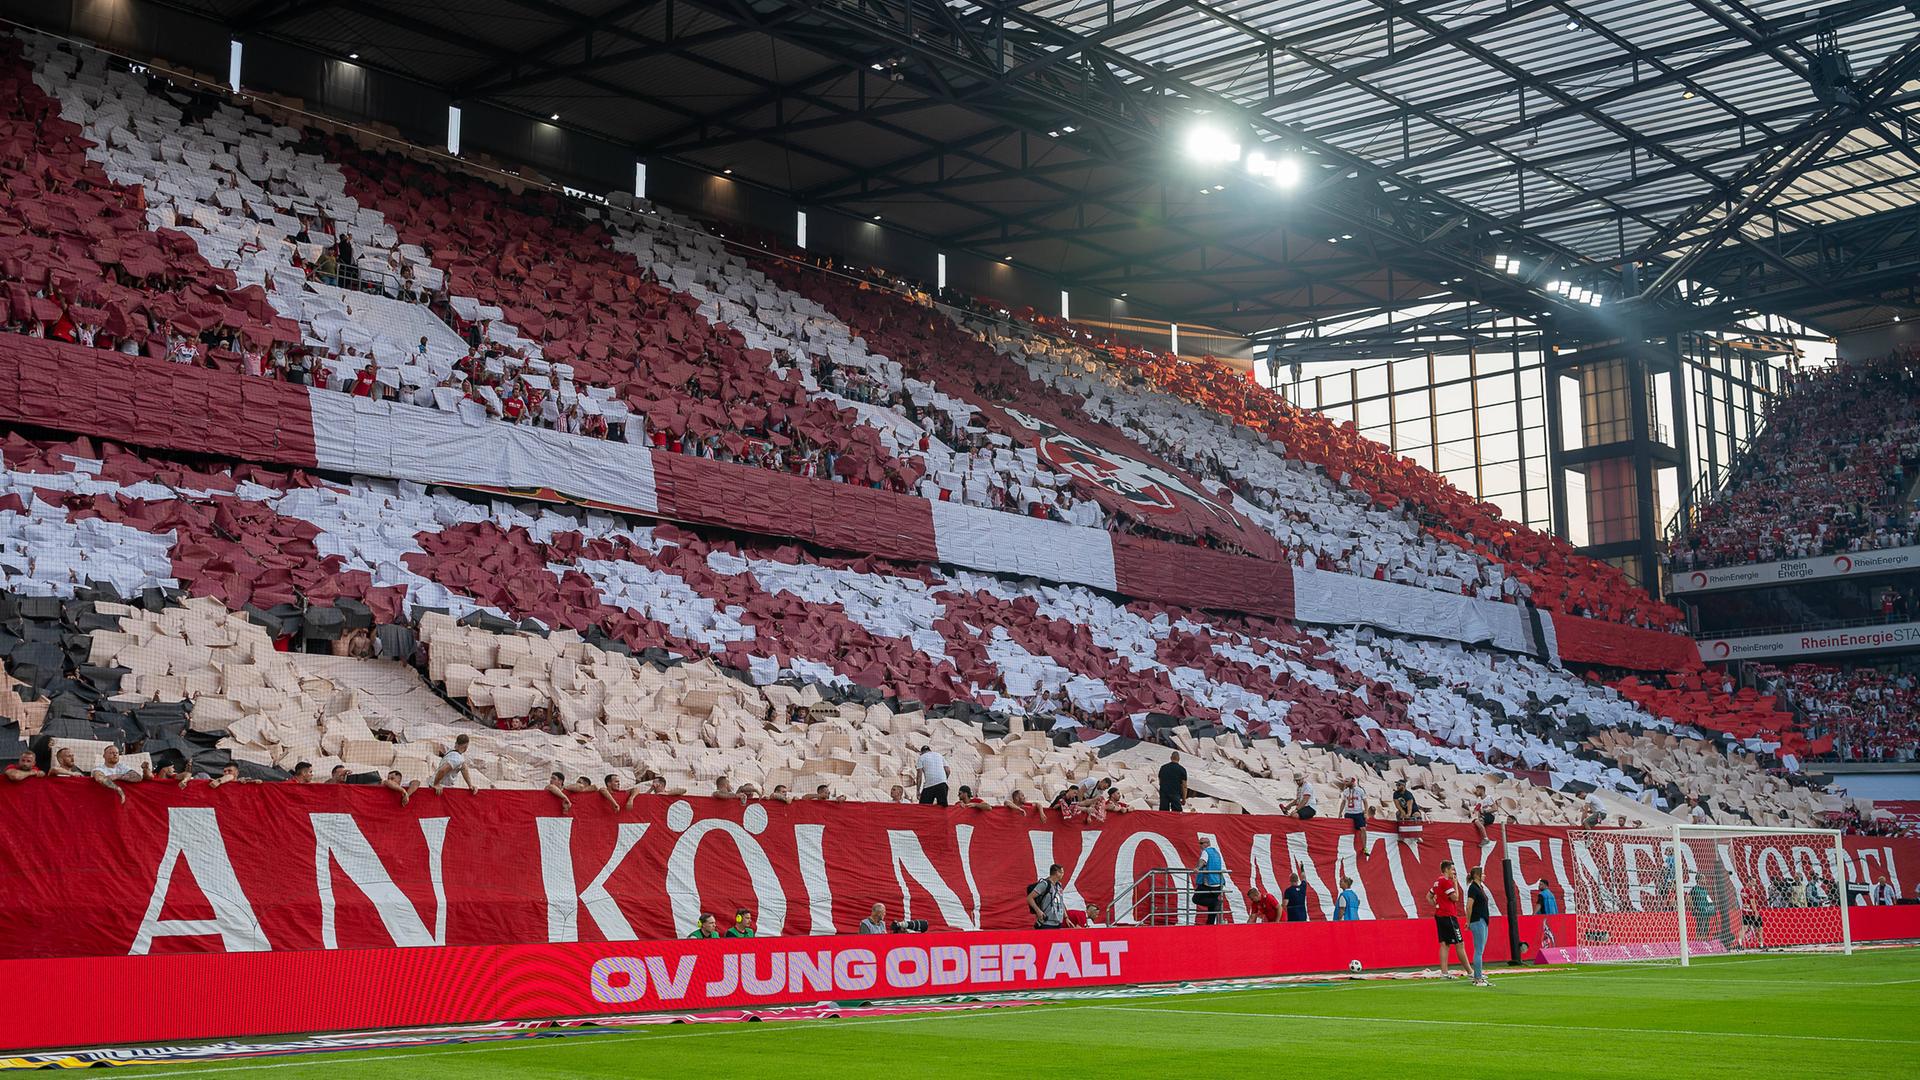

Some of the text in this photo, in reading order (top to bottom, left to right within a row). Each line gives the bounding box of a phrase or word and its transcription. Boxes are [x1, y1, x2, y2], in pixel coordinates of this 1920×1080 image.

[1780, 561, 1807, 571] Rhein
[1854, 554, 1909, 568] RheinEnergie
[1709, 570, 1760, 584] RheinEnergie
[1777, 567, 1814, 579] Energie
[1732, 641, 1784, 653] RheinEnergie
[128, 806, 451, 956] AN
[535, 800, 981, 943] KÖLN
[1028, 829, 1422, 925] KOMMT
[590, 940, 1128, 1004] OV JUNG ODER ALT
